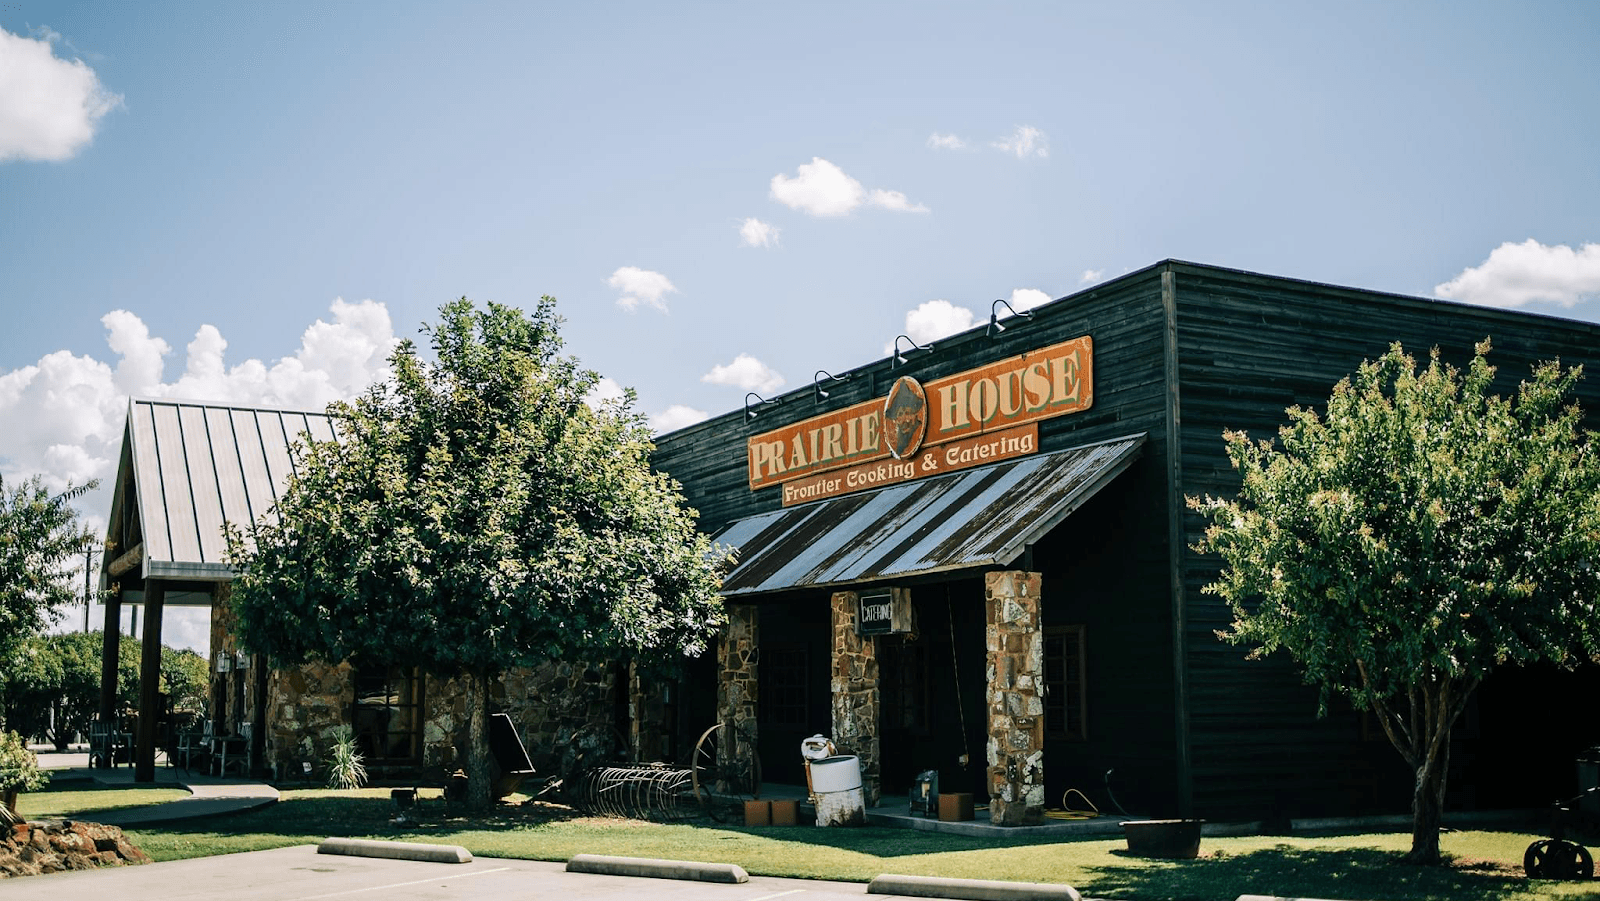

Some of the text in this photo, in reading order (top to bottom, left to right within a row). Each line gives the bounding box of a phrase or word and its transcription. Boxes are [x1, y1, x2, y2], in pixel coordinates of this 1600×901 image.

[750, 349, 1081, 481] PRAIRIE HOUSE
[784, 433, 1034, 503] Frontier Cooking & Catering
